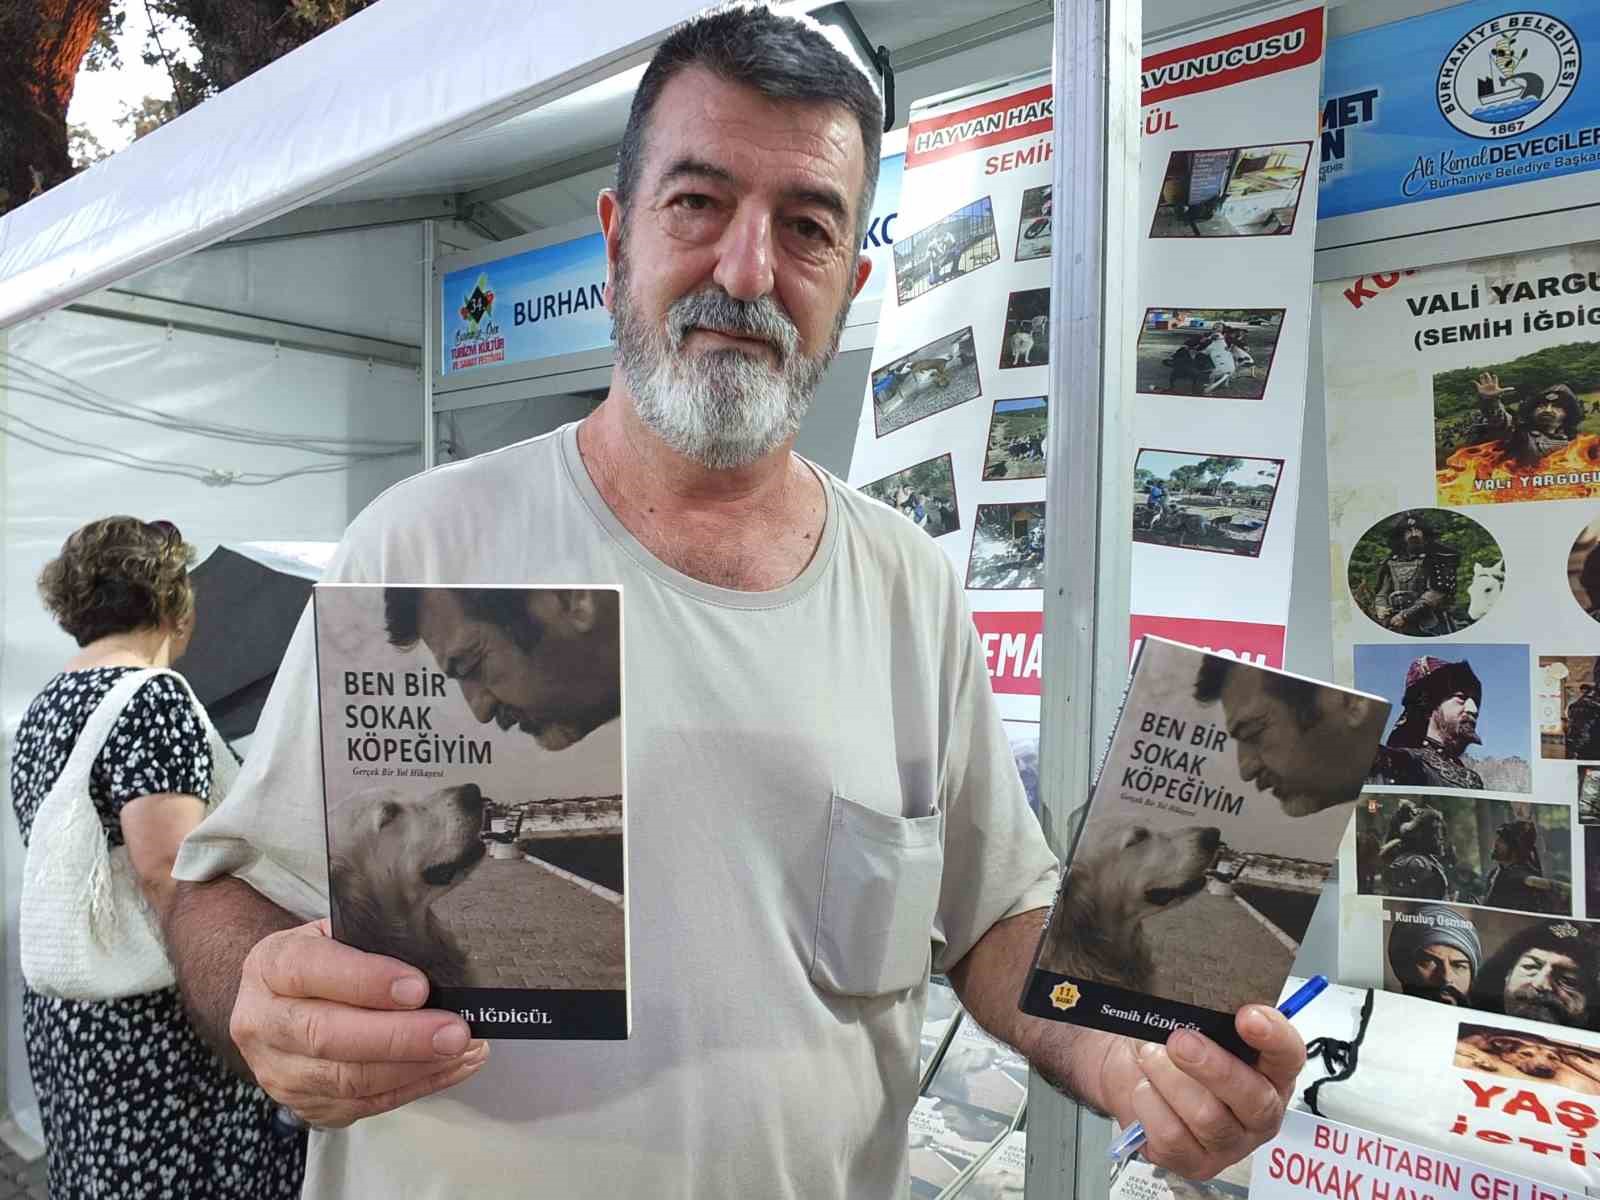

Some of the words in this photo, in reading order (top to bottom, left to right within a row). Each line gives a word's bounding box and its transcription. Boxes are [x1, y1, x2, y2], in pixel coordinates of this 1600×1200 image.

[917, 114, 1002, 151] HAYVAN
[1489, 120, 1526, 136] 1867
[1430, 171, 1492, 190] Burhaniye
[1496, 160, 1551, 178] Belediye
[514, 282, 605, 326] BURHAN
[1407, 284, 1480, 316] VALİ
[1414, 318, 1512, 351] (SEMİH
[344, 671, 395, 697] BEN
[405, 667, 447, 697] BİR
[345, 704, 432, 731] SOKAK
[1140, 711, 1186, 741] BEN
[1190, 723, 1228, 752] BİR
[347, 732, 492, 764] KÖPEĞİYİM
[1130, 739, 1206, 777] SOKAK
[1121, 766, 1245, 816] KÖPEĞİYİM
[1395, 911, 1435, 927] Kuruluş
[479, 1007, 553, 1024] İĞDİGÜL
[1100, 1003, 1141, 1023] Semih
[1462, 1079, 1599, 1138] YAŞ
[1268, 1147, 1364, 1200] SOKAK
[1314, 1124, 1349, 1155] BU
[1356, 1137, 1462, 1192] KİTABIN
